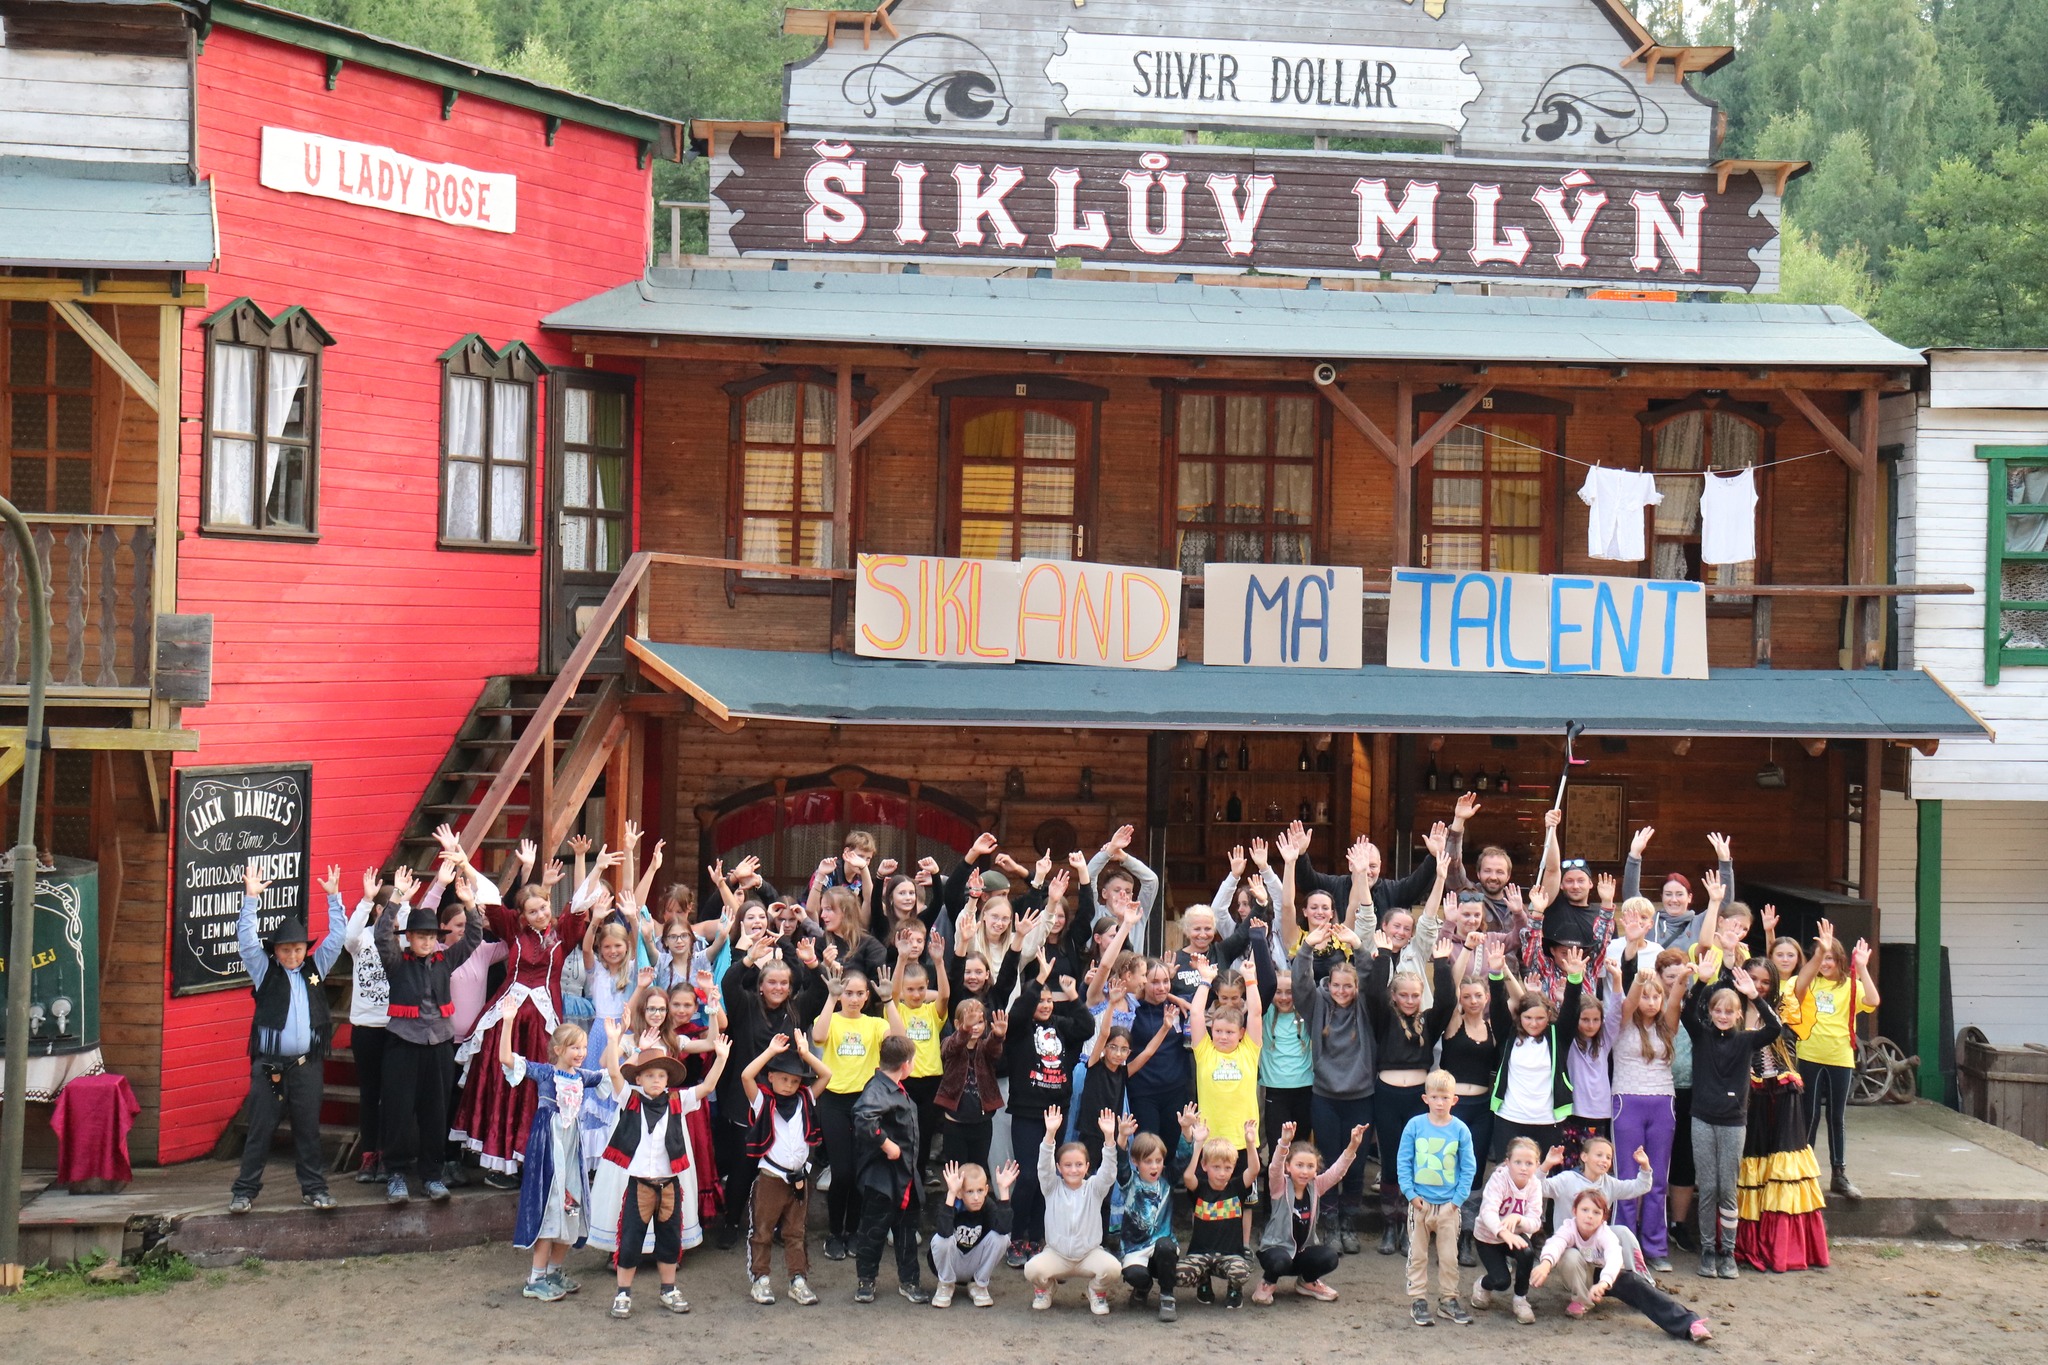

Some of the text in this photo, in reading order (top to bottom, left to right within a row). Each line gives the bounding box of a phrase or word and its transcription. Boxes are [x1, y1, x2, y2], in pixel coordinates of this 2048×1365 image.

[1133, 50, 1397, 108] SILVER DOLLAR
[304, 141, 491, 222] U LADY ROSE
[803, 139, 1708, 274] ŠIKLŮV MLÝN
[1396, 572, 1700, 675] TALENT
[190, 790, 296, 837] JACK DANIEL'S
[214, 830, 264, 851] Old Time
[246, 851, 301, 881] WHISKEY
[189, 894, 213, 918] JACK
[256, 885, 300, 911] STILLERY
[202, 922, 221, 940] LEM
[32, 949, 57, 970] LEJ
[1499, 1196, 1527, 1217] GA
